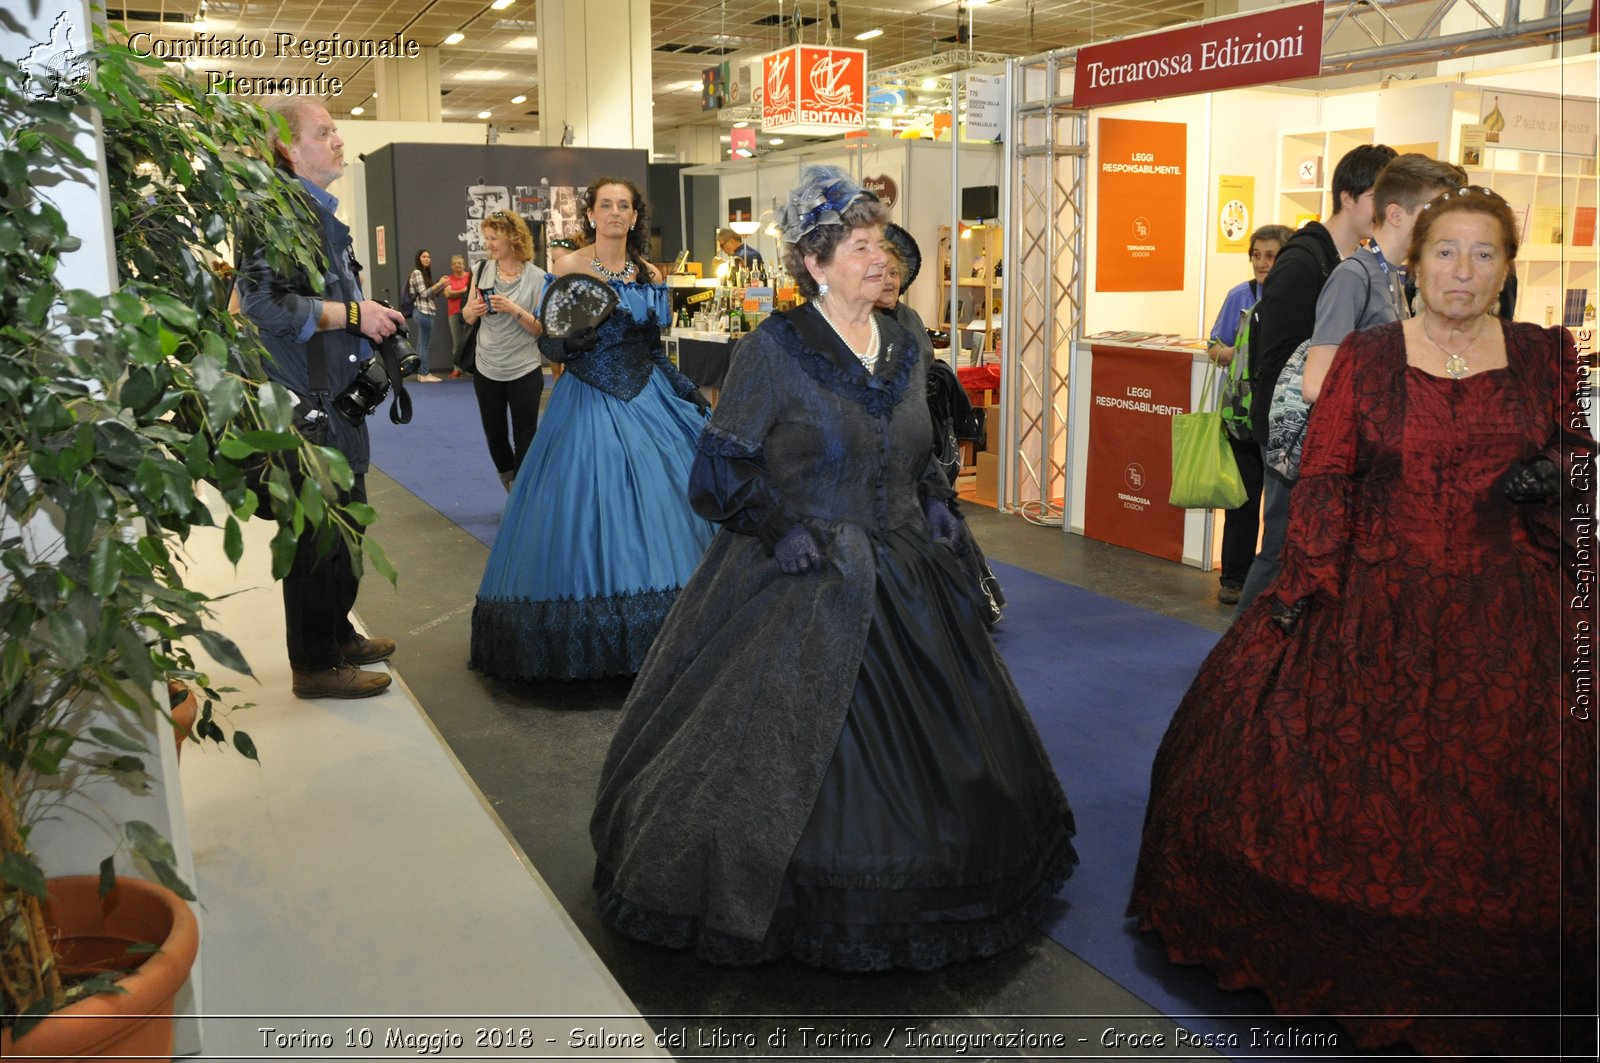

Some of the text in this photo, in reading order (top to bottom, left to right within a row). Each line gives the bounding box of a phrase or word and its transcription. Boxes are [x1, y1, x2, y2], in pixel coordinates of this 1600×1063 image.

[1087, 25, 1304, 88] Terrarossa Edizioni
[764, 111, 796, 128] EDITALIA
[801, 110, 864, 125] EDITALIA
[1131, 153, 1154, 162] LEGGI
[1102, 163, 1182, 175] RESPONSABILMENTE.
[349, 301, 358, 325] Niko
[1126, 386, 1152, 399] LEGGI
[1118, 493, 1151, 505] TERRAROSSA
[1124, 501, 1144, 511] EDIZIONI
